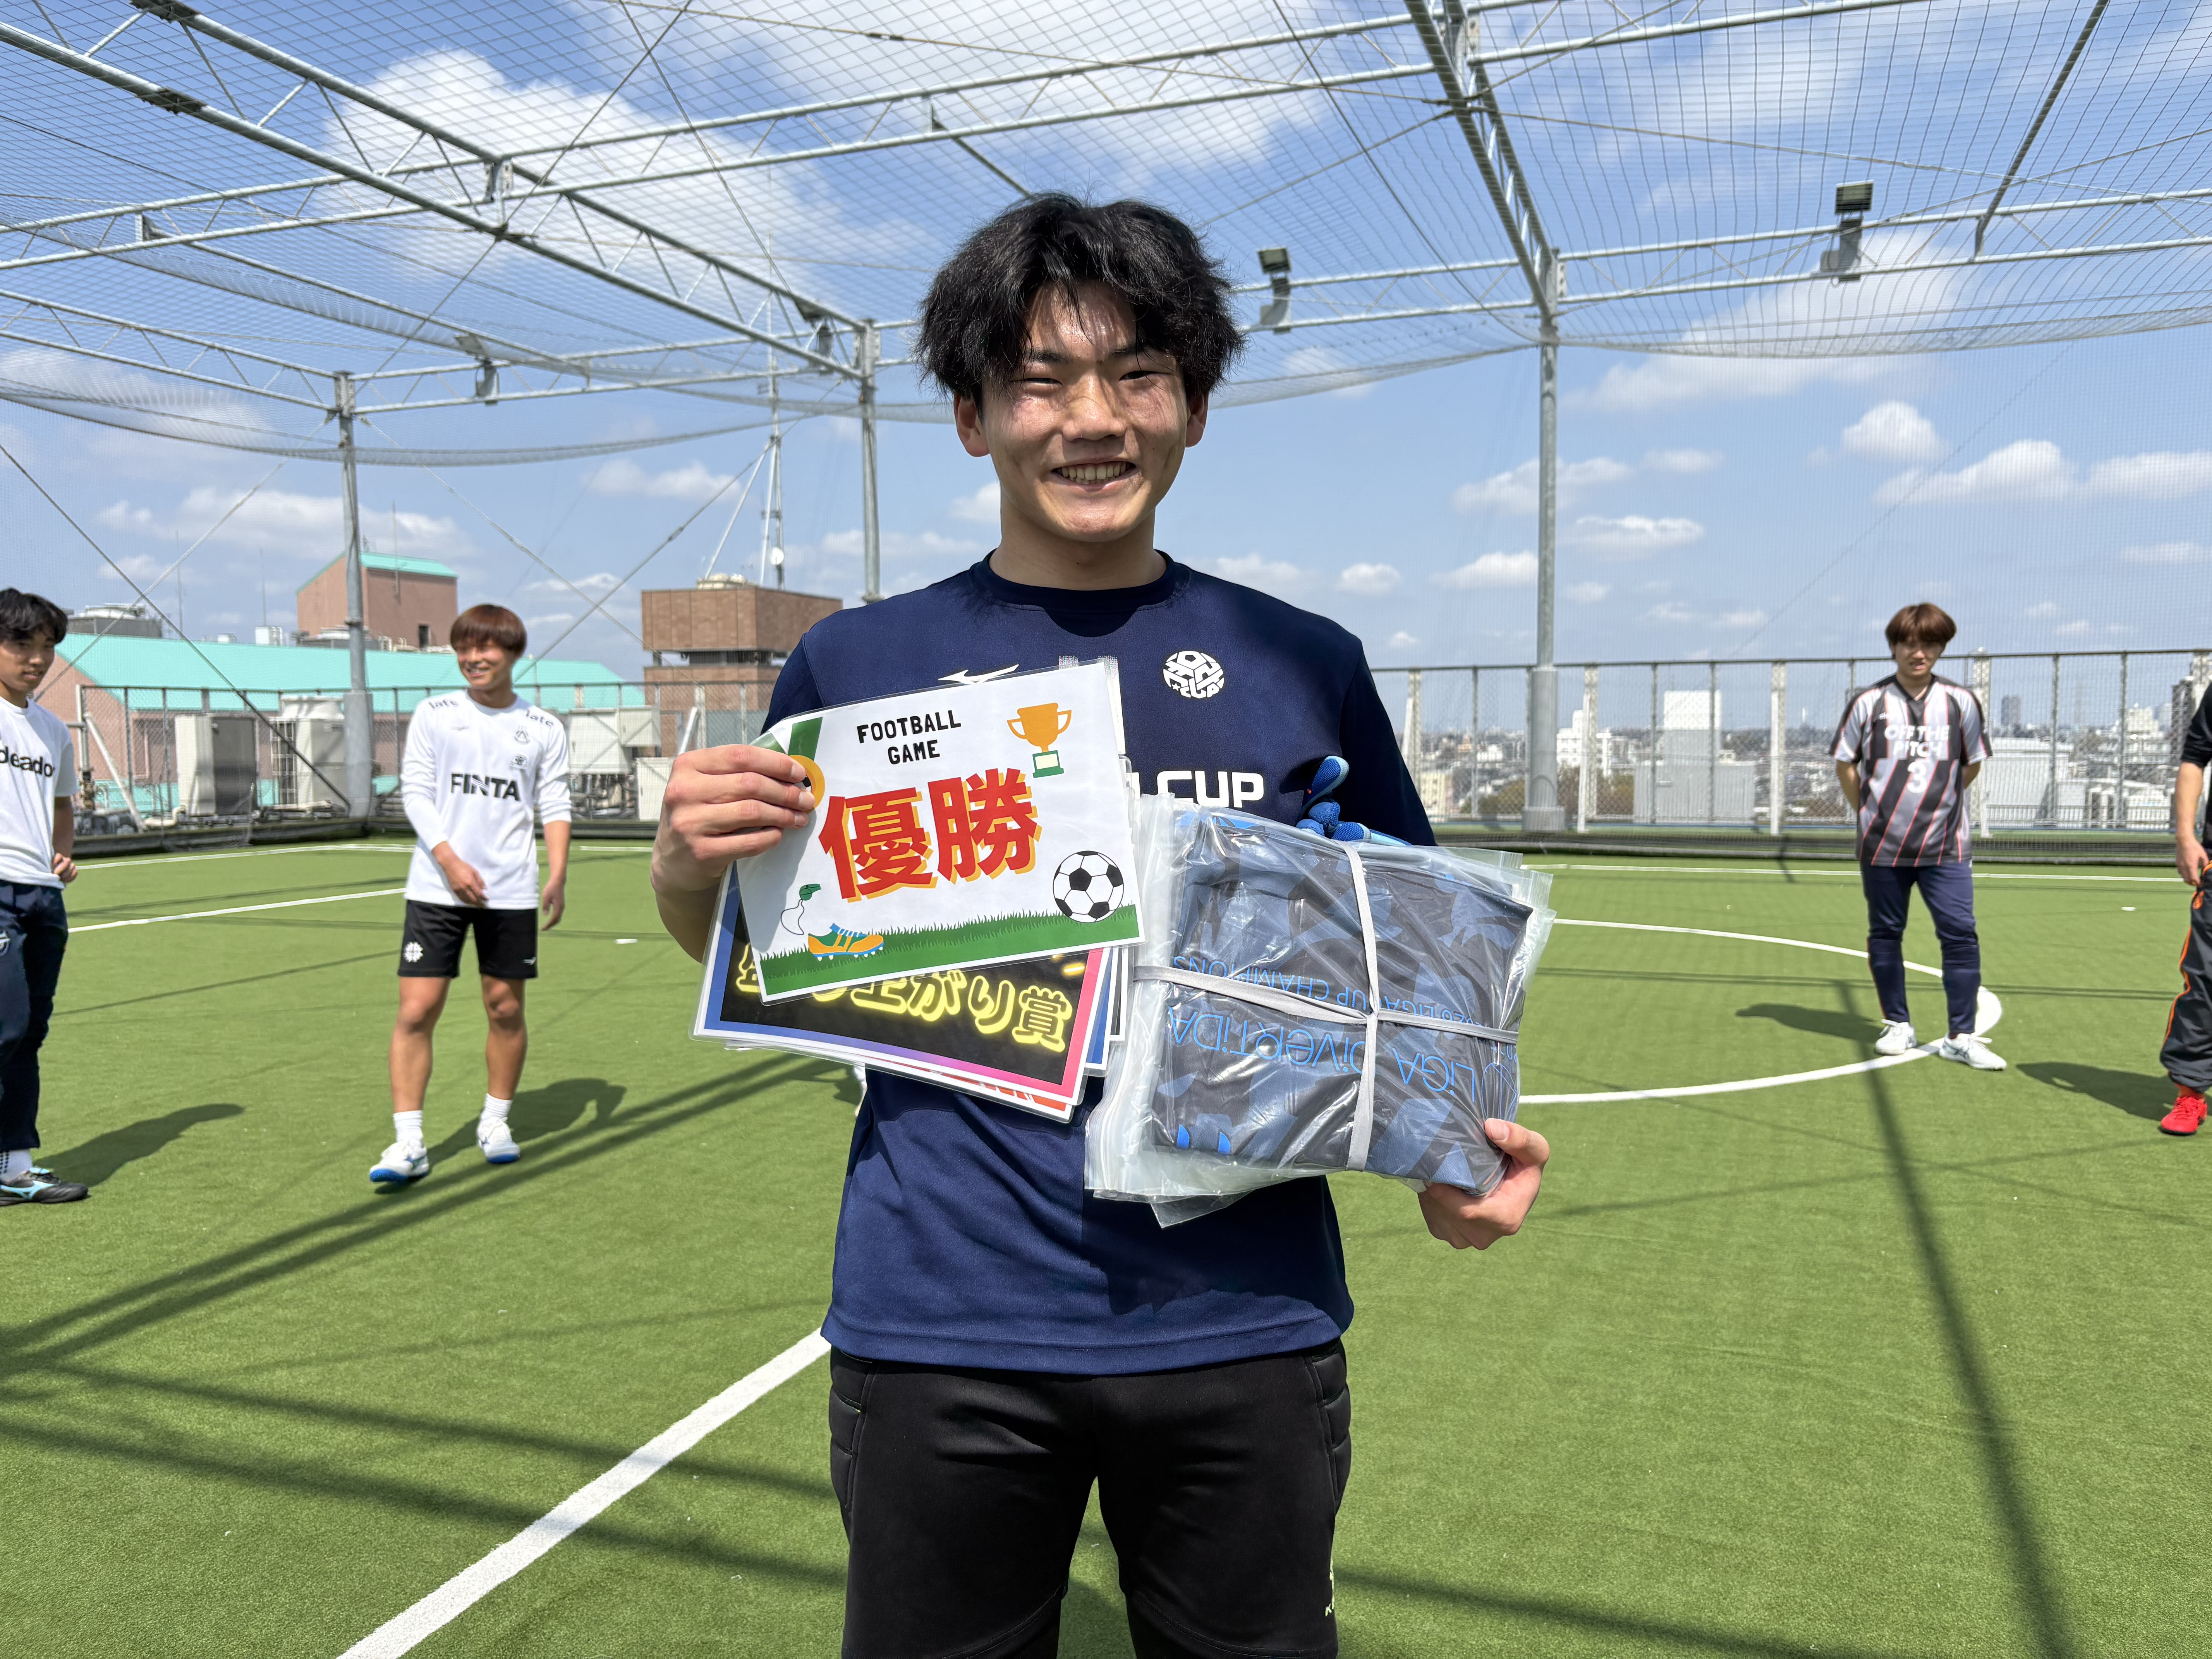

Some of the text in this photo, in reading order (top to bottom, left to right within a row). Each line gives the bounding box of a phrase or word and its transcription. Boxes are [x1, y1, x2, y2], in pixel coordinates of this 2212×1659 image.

[857, 709, 962, 744] FOOTBALL
[1884, 725, 1950, 740] OFF THE
[887, 740, 941, 765] GAME
[1893, 740, 1943, 757] PITCH
[450, 773, 521, 801] FINTA
[1157, 770, 1264, 808] CUP
[1906, 761, 1927, 793] 3
[818, 768, 1043, 903] 優勝
